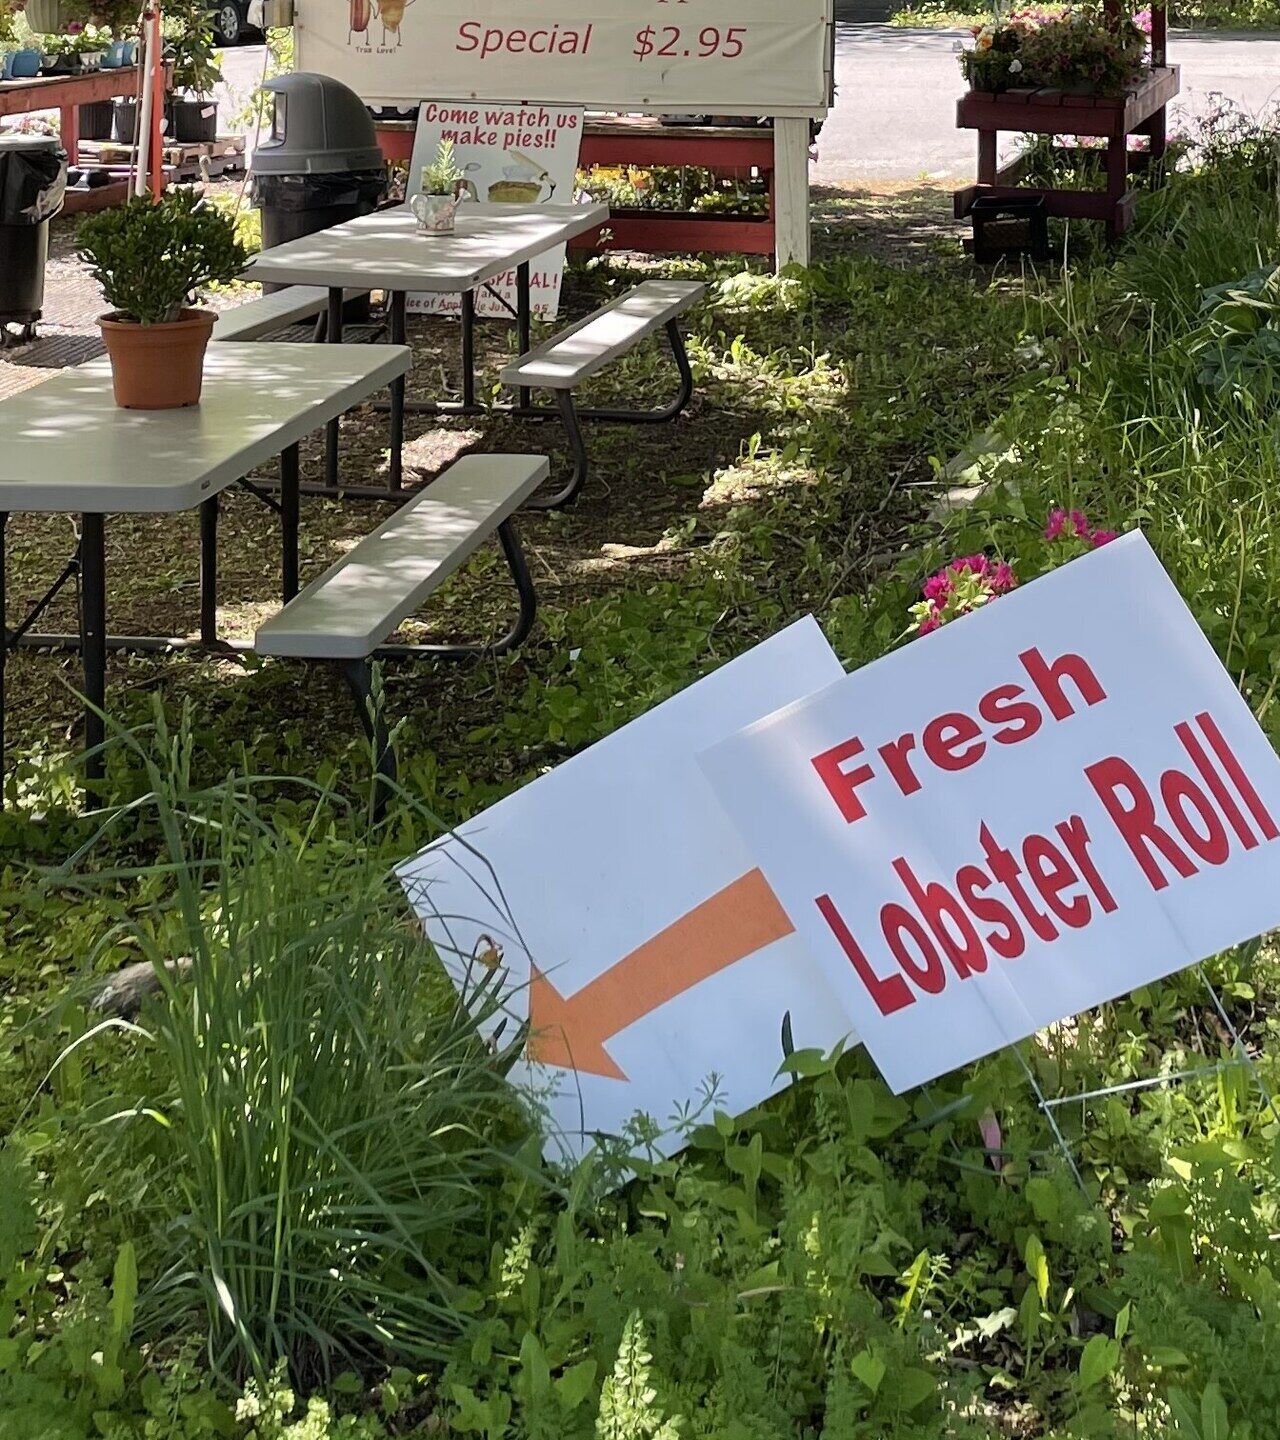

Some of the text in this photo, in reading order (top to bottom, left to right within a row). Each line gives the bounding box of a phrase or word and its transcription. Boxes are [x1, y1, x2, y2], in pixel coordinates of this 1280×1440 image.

[455, 21, 748, 62] Special $2.95
[425, 104, 578, 129] Come watch us
[441, 126, 557, 151] make pies!!
[423, 296, 436, 309] of
[811, 646, 1107, 823] Fresh
[815, 712, 1280, 1015] Lobster Roll
